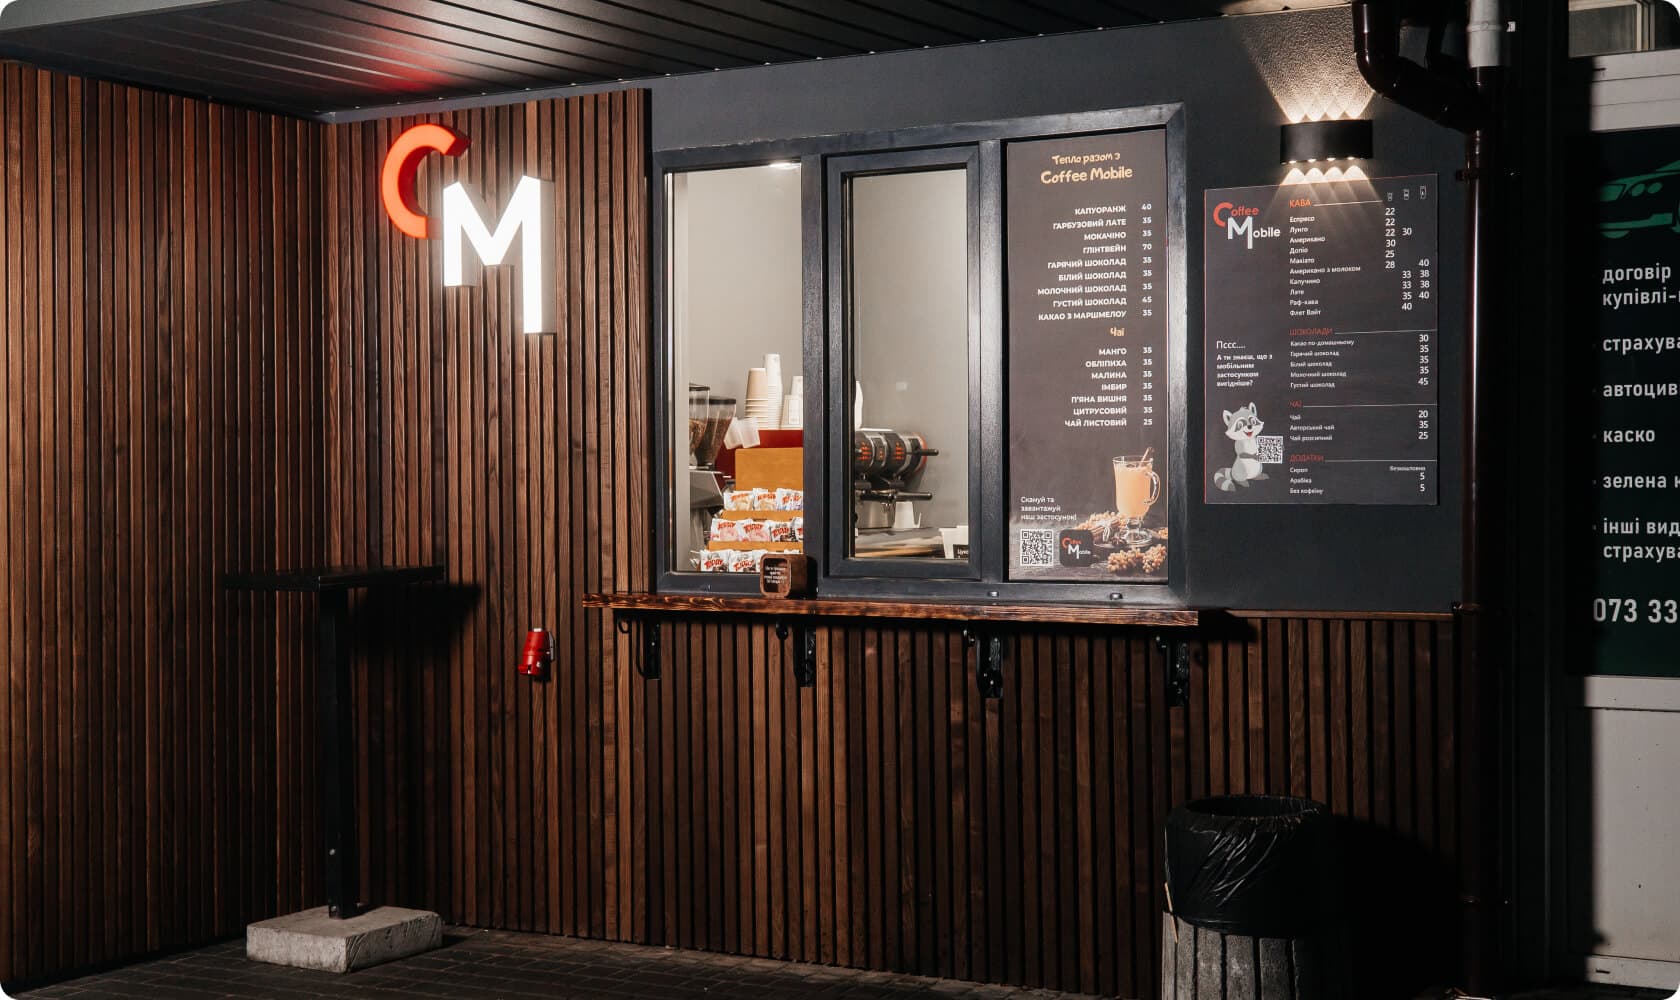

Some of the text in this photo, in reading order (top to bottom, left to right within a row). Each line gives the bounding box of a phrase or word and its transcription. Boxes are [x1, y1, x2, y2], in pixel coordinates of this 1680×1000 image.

[1052, 155, 1081, 165] Тепло
[1083, 153, 1113, 165] разом
[1041, 166, 1133, 184] Coffee Mobile
[1289, 199, 1312, 208] КАВА
[1075, 205, 1126, 216] КАПУОРАНЖ
[1213, 202, 1259, 228] Coffee
[1385, 207, 1396, 216] 22
[1053, 219, 1104, 230] ГАРБУЗОВИЙ
[1385, 218, 1396, 226] 22
[1084, 232, 1126, 240] МОКАЧІНО
[1227, 216, 1281, 249] Mobile
[1385, 229, 1396, 237] 22
[1402, 228, 1412, 236] 30
[1386, 239, 1396, 247] 30
[1083, 244, 1126, 254] ГЛІНТВЕЙН
[1385, 250, 1395, 258] 25
[1047, 260, 1083, 269] ГАРЯЧИЙ
[1084, 258, 1127, 267] ШОКОЛАД
[1385, 261, 1396, 269] 28
[1419, 259, 1429, 267] 40
[1058, 272, 1083, 281] БІЛИЙ
[1084, 272, 1127, 280] ШОКОЛАД
[1402, 270, 1412, 279] 33
[1420, 270, 1430, 278] 38
[1602, 262, 1671, 284] договір
[1402, 281, 1412, 289] 33
[1420, 280, 1430, 288] 38
[1037, 285, 1083, 295] МОЛОЧНИЙ
[1084, 285, 1127, 293] ШОКОЛАД
[1402, 291, 1412, 300] 35
[1419, 291, 1430, 299] 40
[1602, 286, 1680, 310] купівлі-
[1053, 299, 1083, 308] ГУСТИЙ
[1085, 298, 1127, 307] ШОКОЛАД
[1401, 302, 1412, 310] 40
[1038, 312, 1066, 321] КАКАО
[1067, 312, 1072, 320] З
[1073, 310, 1127, 319] МАРШМЕЛОУ
[1419, 334, 1429, 342] 30
[1098, 348, 1127, 356] МАНГО
[1419, 345, 1429, 353] 35
[1085, 359, 1127, 368] ОБЛІПИХА
[1419, 356, 1429, 364] 35
[1091, 371, 1127, 379] МАЛИНА
[1419, 367, 1429, 375] 35
[1101, 382, 1152, 391] ІМБИР 35
[1097, 395, 1127, 403] ВИШНЯ
[1073, 406, 1127, 416] ЦИТРУСОВИЙ
[1418, 410, 1429, 418] 20
[1064, 418, 1081, 427] ЧАЙ
[1083, 418, 1127, 426] ЛИСТОВИЙ
[1419, 421, 1429, 429] 35
[1418, 432, 1429, 440] 25
[1603, 430, 1655, 443] каско
[1420, 472, 1425, 480] 5
[1603, 476, 1667, 489] зелена
[1420, 484, 1425, 492] 5
[1020, 496, 1046, 504] Скануй
[1603, 517, 1639, 534] інші
[1593, 598, 1678, 623] 073 33
